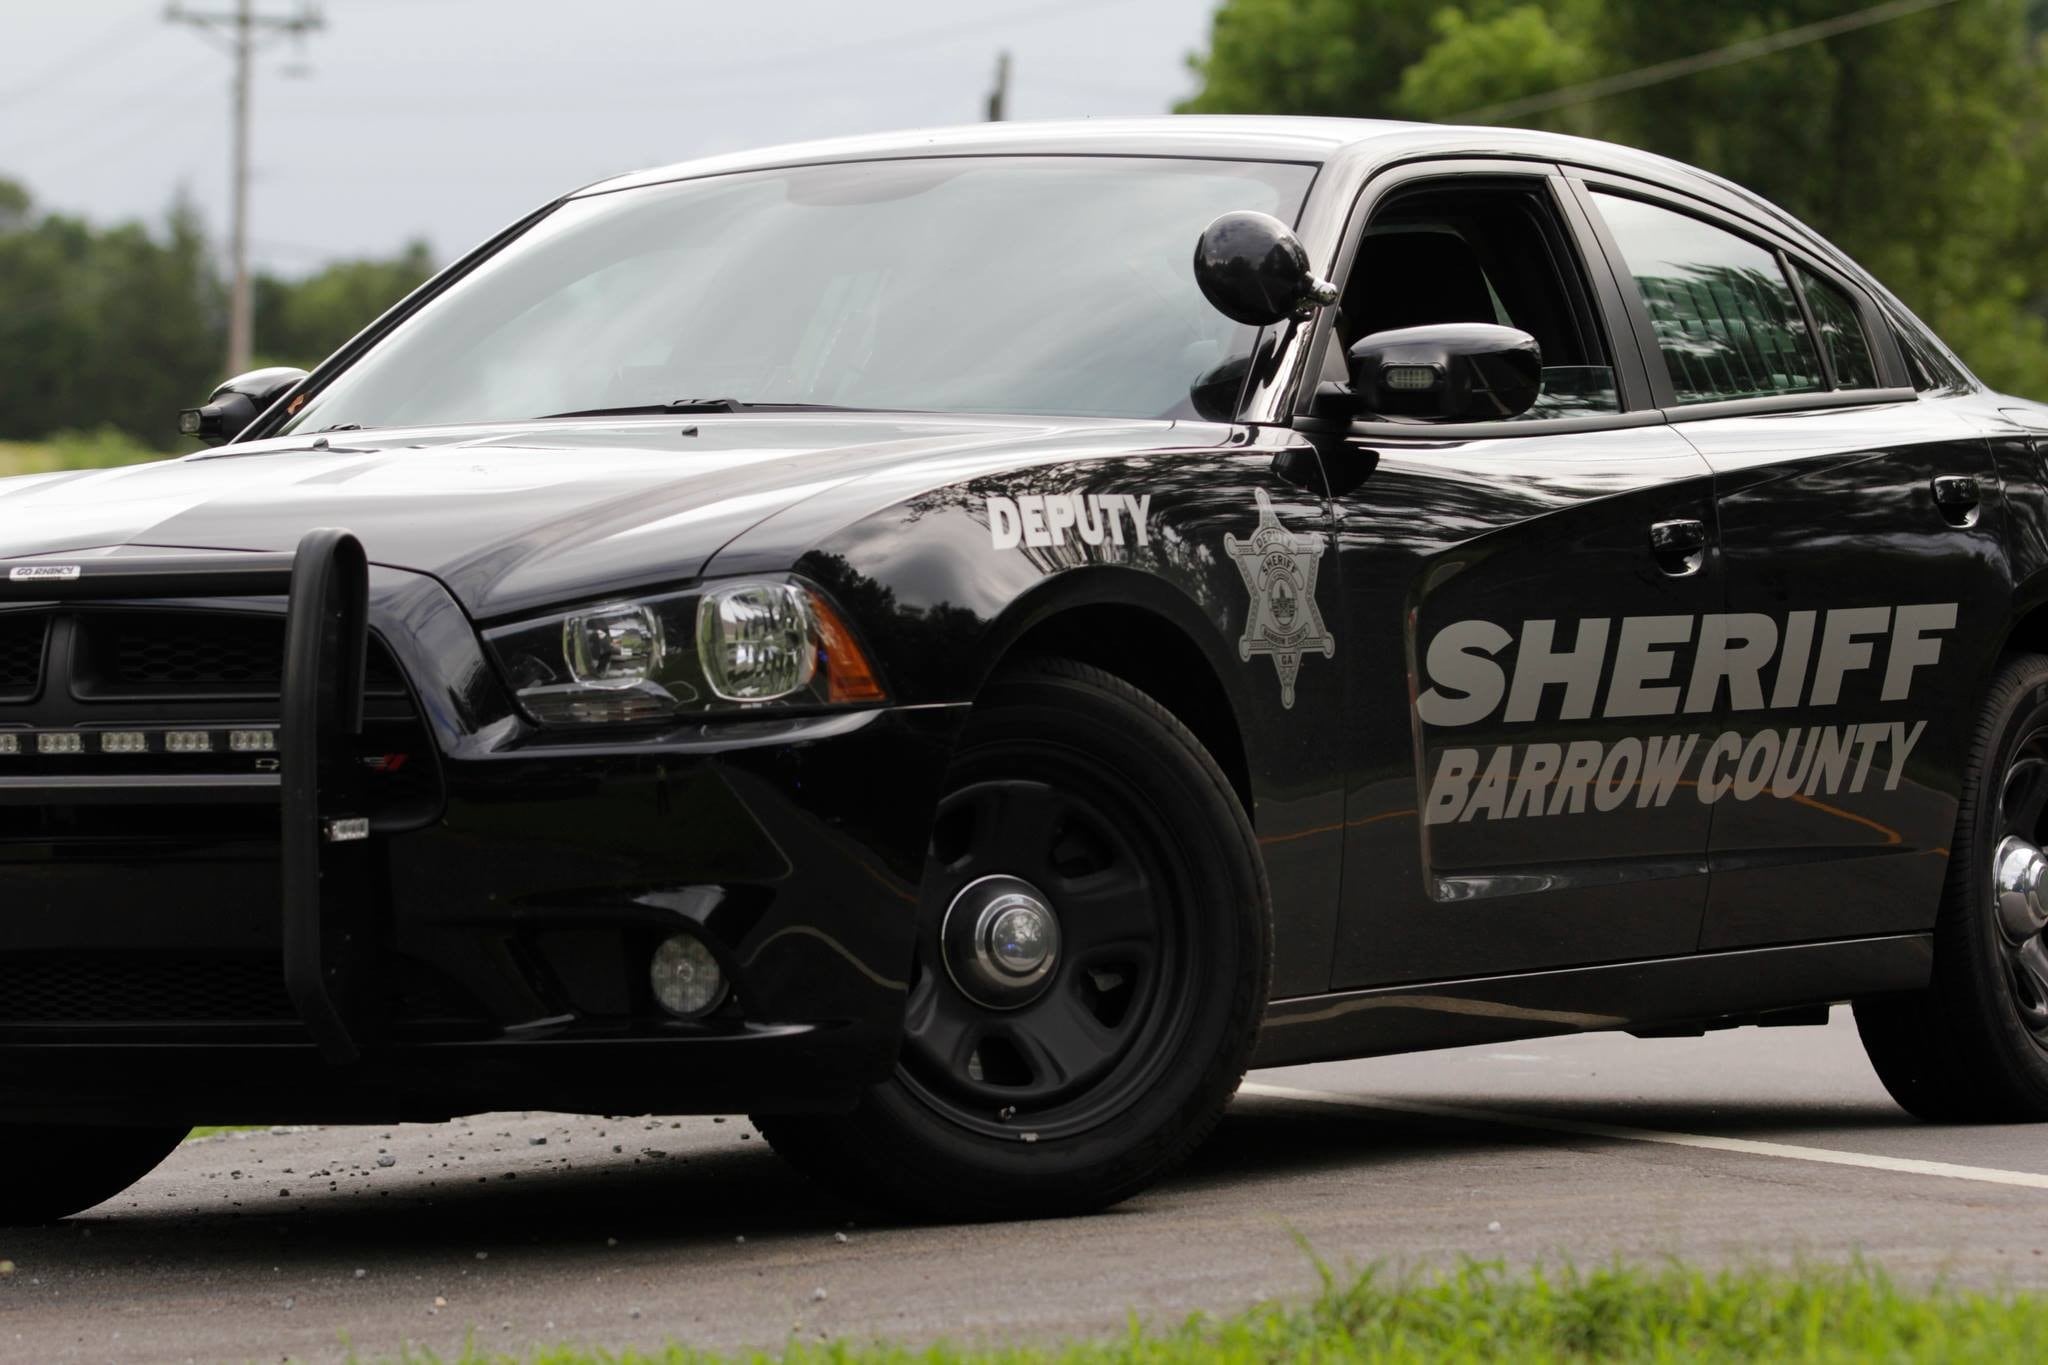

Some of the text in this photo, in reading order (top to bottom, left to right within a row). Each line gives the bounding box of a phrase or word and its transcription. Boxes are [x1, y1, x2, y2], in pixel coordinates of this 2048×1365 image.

[986, 493, 1151, 550] DEPUTY
[1256, 530, 1292, 549] DEPUTY
[1263, 554, 1296, 576] SHERIFF
[1281, 655, 1293, 665] GA
[1416, 603, 1958, 726] SHERIFF
[1424, 721, 1927, 825] BARROW COUNTY
